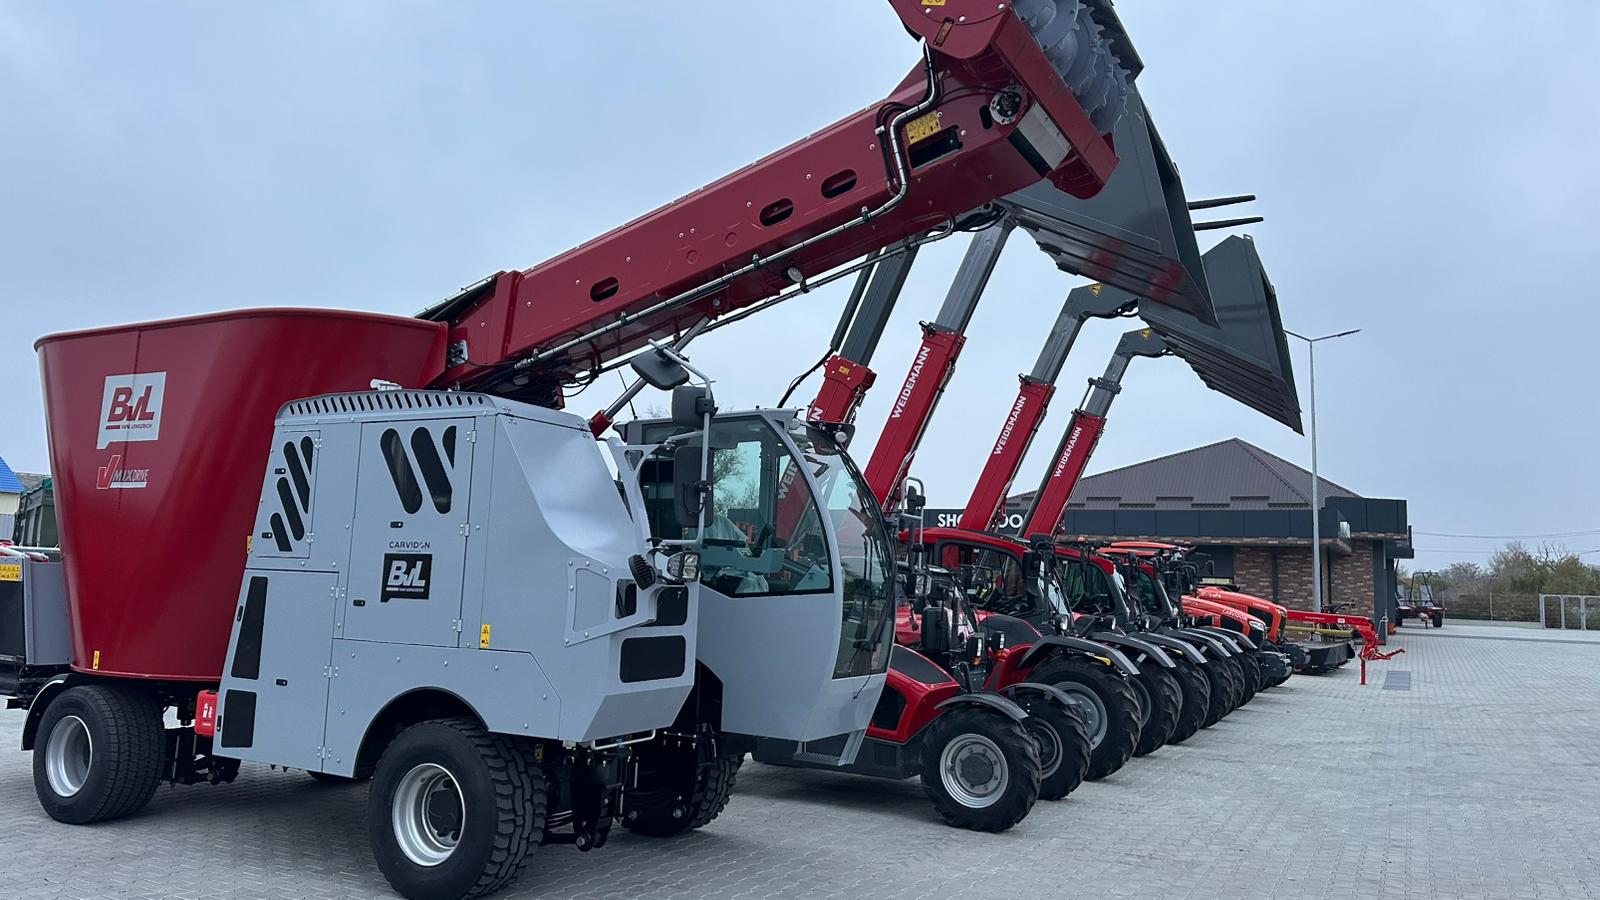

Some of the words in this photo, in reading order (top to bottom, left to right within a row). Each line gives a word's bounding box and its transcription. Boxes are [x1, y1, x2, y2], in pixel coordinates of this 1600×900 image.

[891, 346, 931, 419] WEIDEMANN
[993, 395, 1027, 455] WEIDEMANN
[1053, 426, 1082, 478] WEIDEMANN
